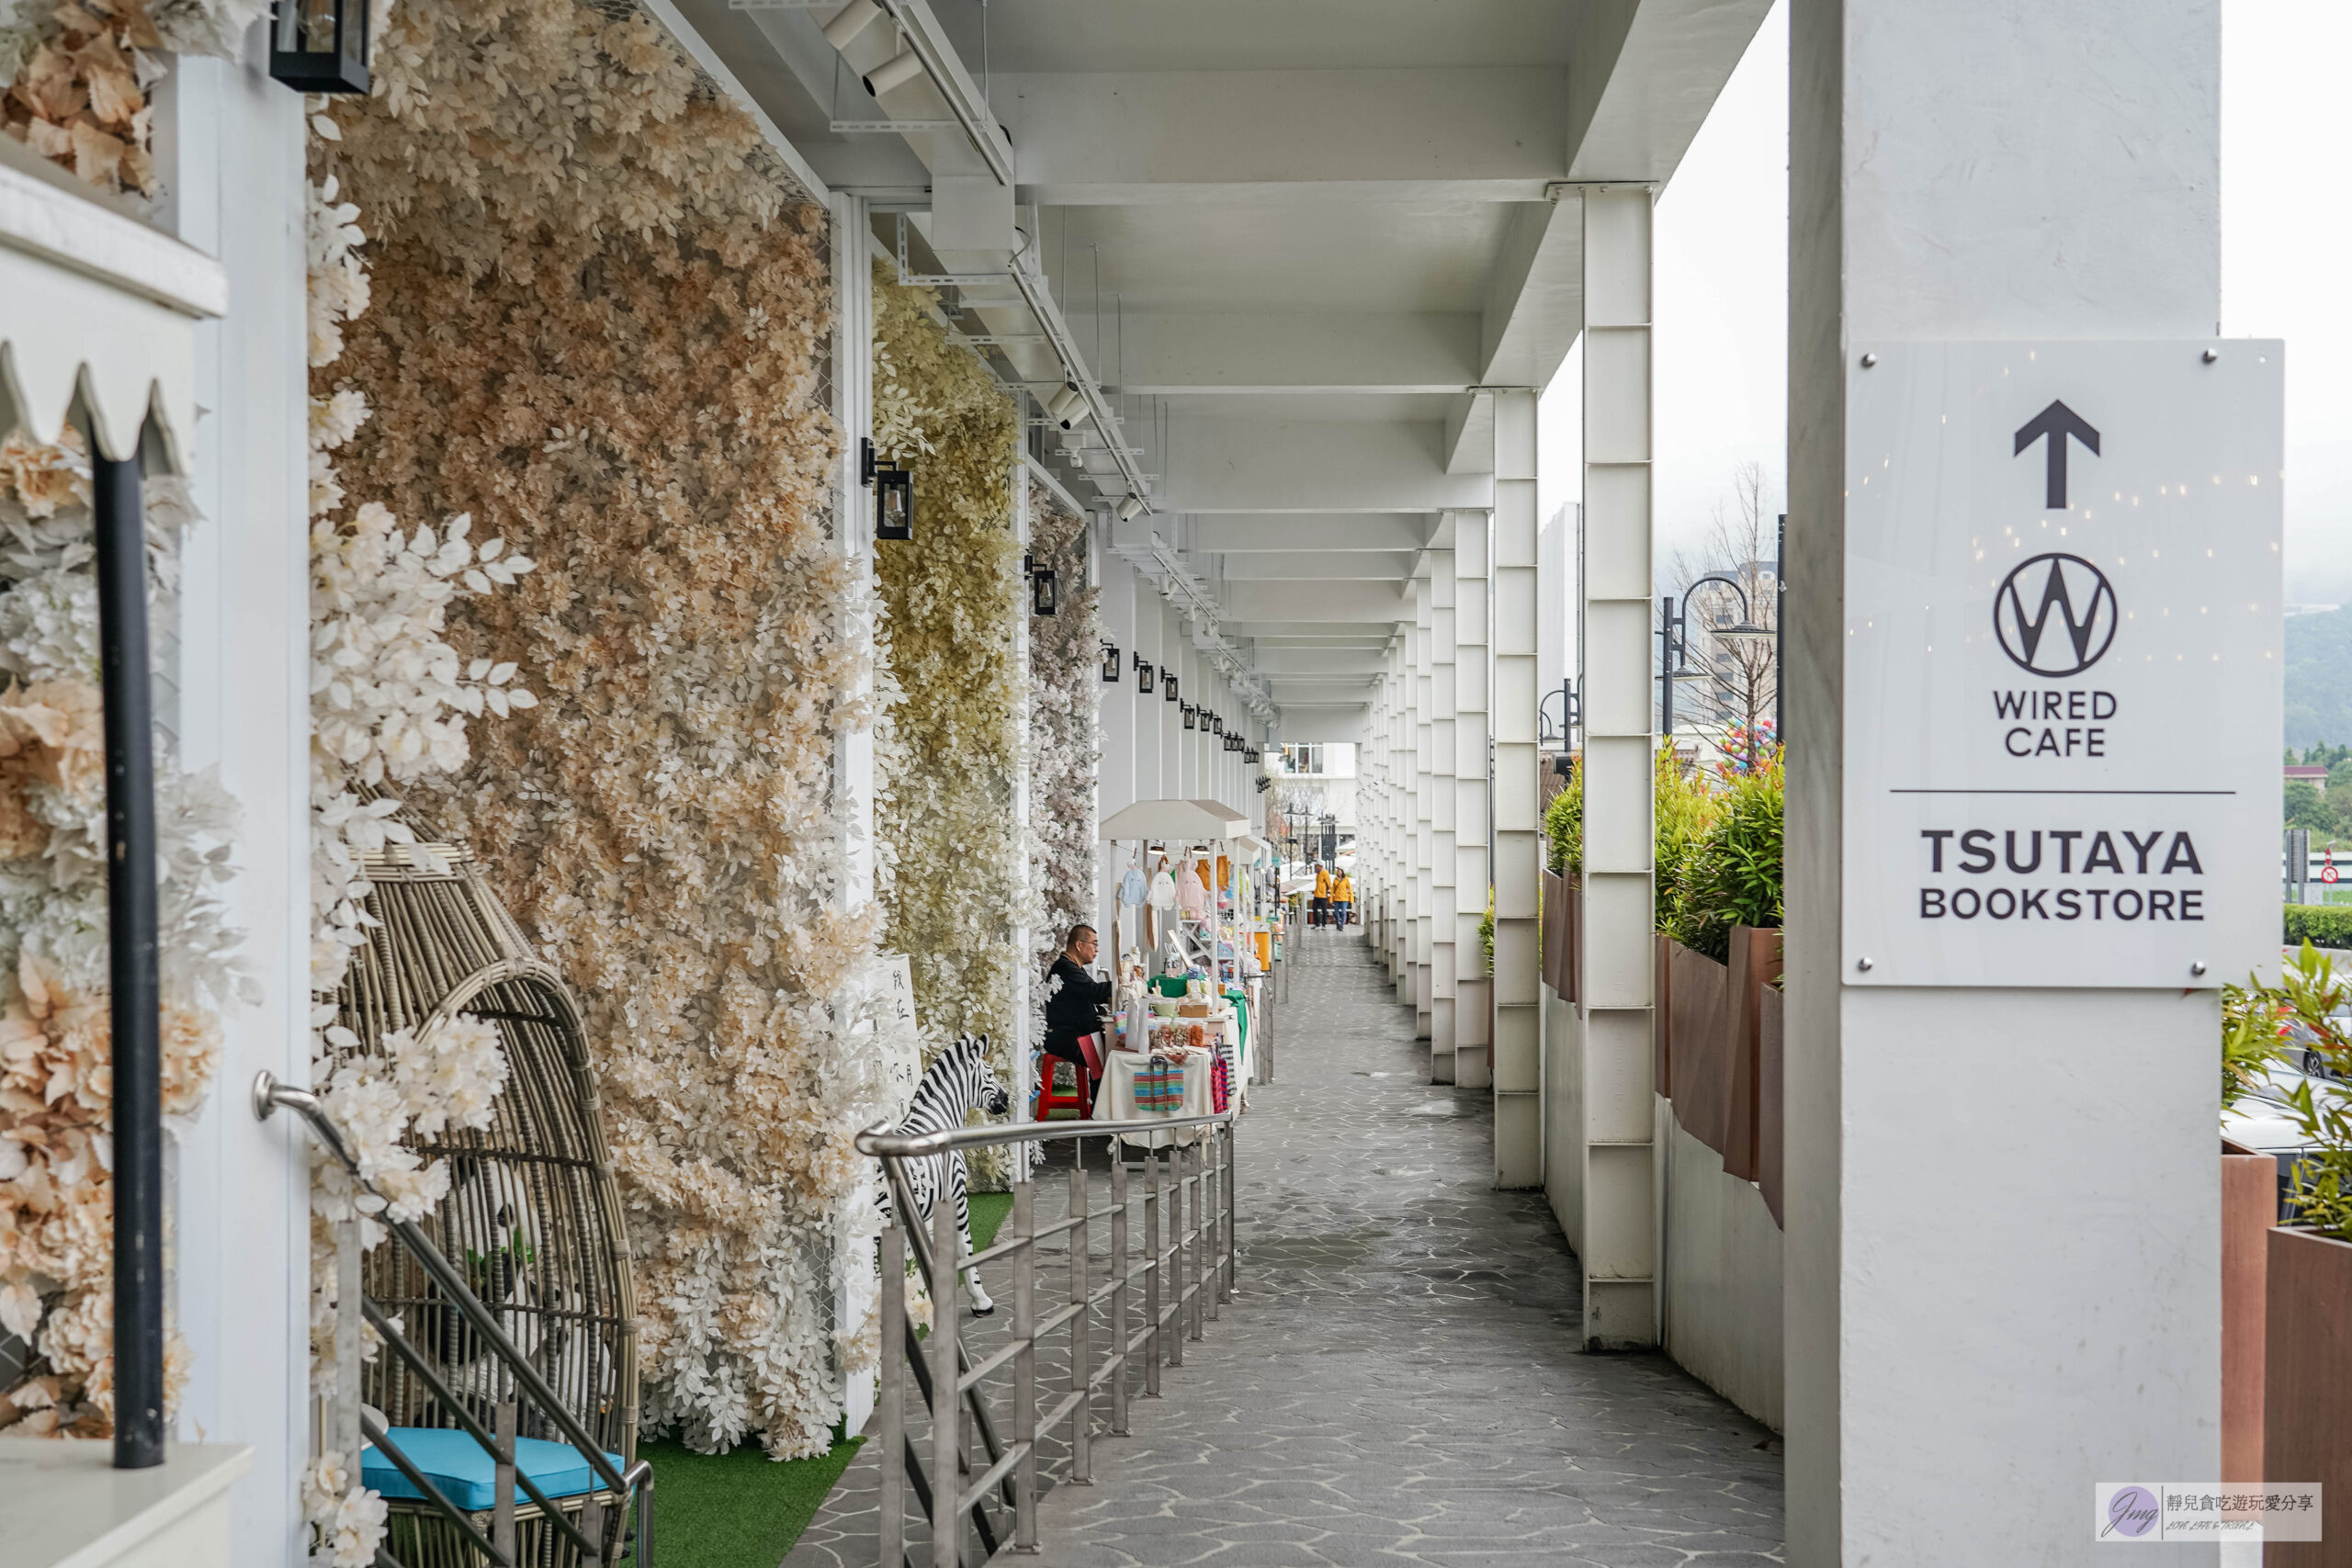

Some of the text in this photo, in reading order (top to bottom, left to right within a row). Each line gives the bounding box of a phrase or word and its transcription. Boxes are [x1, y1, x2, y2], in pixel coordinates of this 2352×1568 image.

[1993, 691, 2117, 720] WIRED
[2005, 728, 2105, 757] CAFE
[1921, 829, 2203, 874] TSUTAYA
[1920, 887, 2204, 920] BOOKSTORE
